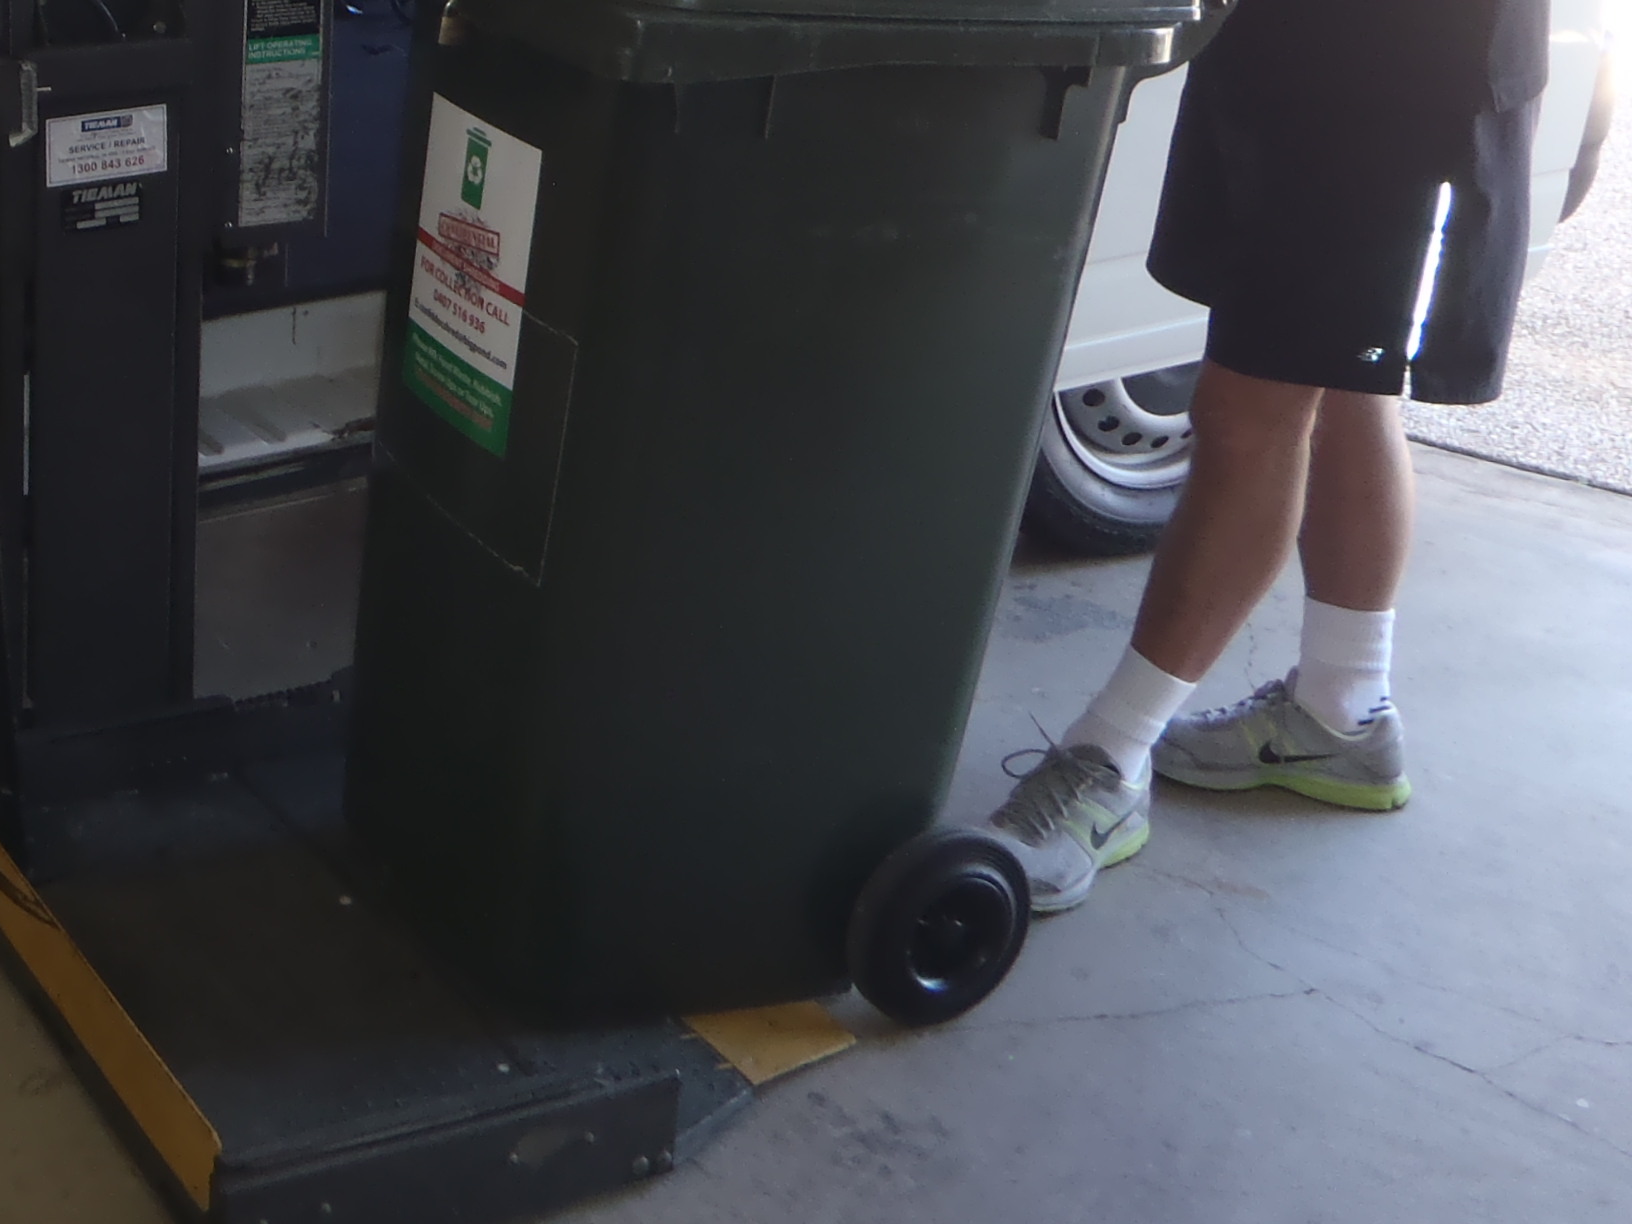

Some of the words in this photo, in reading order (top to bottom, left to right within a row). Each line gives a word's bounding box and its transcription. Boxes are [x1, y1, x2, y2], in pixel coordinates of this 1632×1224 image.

[248, 41, 265, 51] LIFT
[267, 39, 313, 49] OPERATING
[248, 48, 306, 59] INSTRUCTIONS
[69, 142, 105, 154] SERVICE
[114, 137, 145, 148] REPAIR
[72, 163, 97, 174] 1300
[101, 159, 121, 170] 843
[125, 155, 145, 167] 626
[72, 181, 137, 204] TIEMAN
[421, 255, 434, 276] FOR
[435, 268, 485, 310] COLLECTION
[486, 300, 510, 326] CALL
[452, 303, 468, 322] 516
[469, 314, 486, 333] 936
